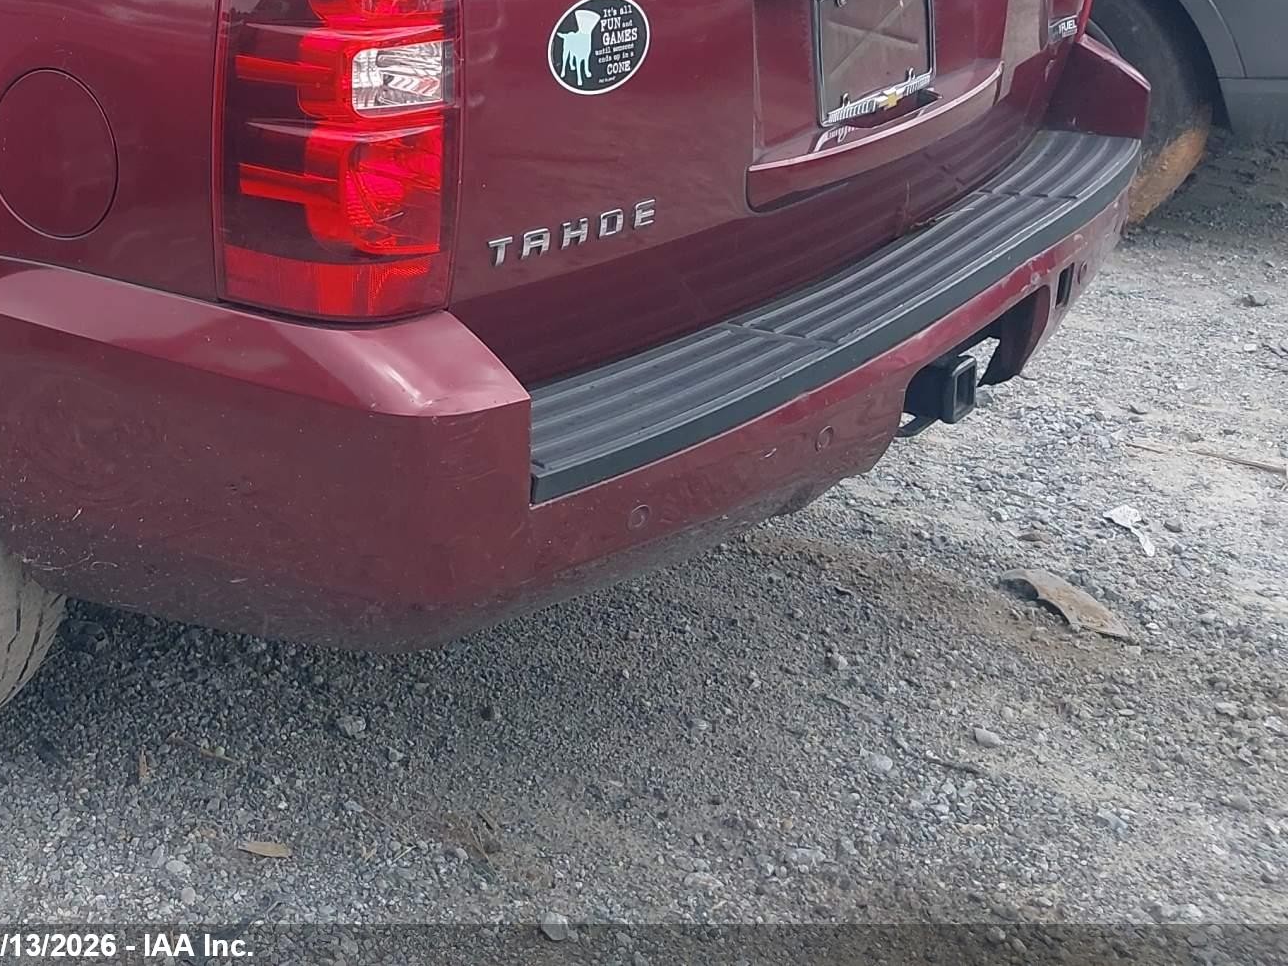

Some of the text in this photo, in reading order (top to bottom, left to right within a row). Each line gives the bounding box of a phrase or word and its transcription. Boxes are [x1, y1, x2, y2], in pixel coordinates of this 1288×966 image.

[603, 5, 632, 18] It's all
[600, 17, 632, 32] FUN and
[602, 28, 638, 46] GAMES
[595, 47, 611, 56] until
[598, 55, 612, 64] ends
[622, 51, 629, 59] in
[606, 60, 631, 75] CONE
[487, 199, 656, 267] TAHOE
